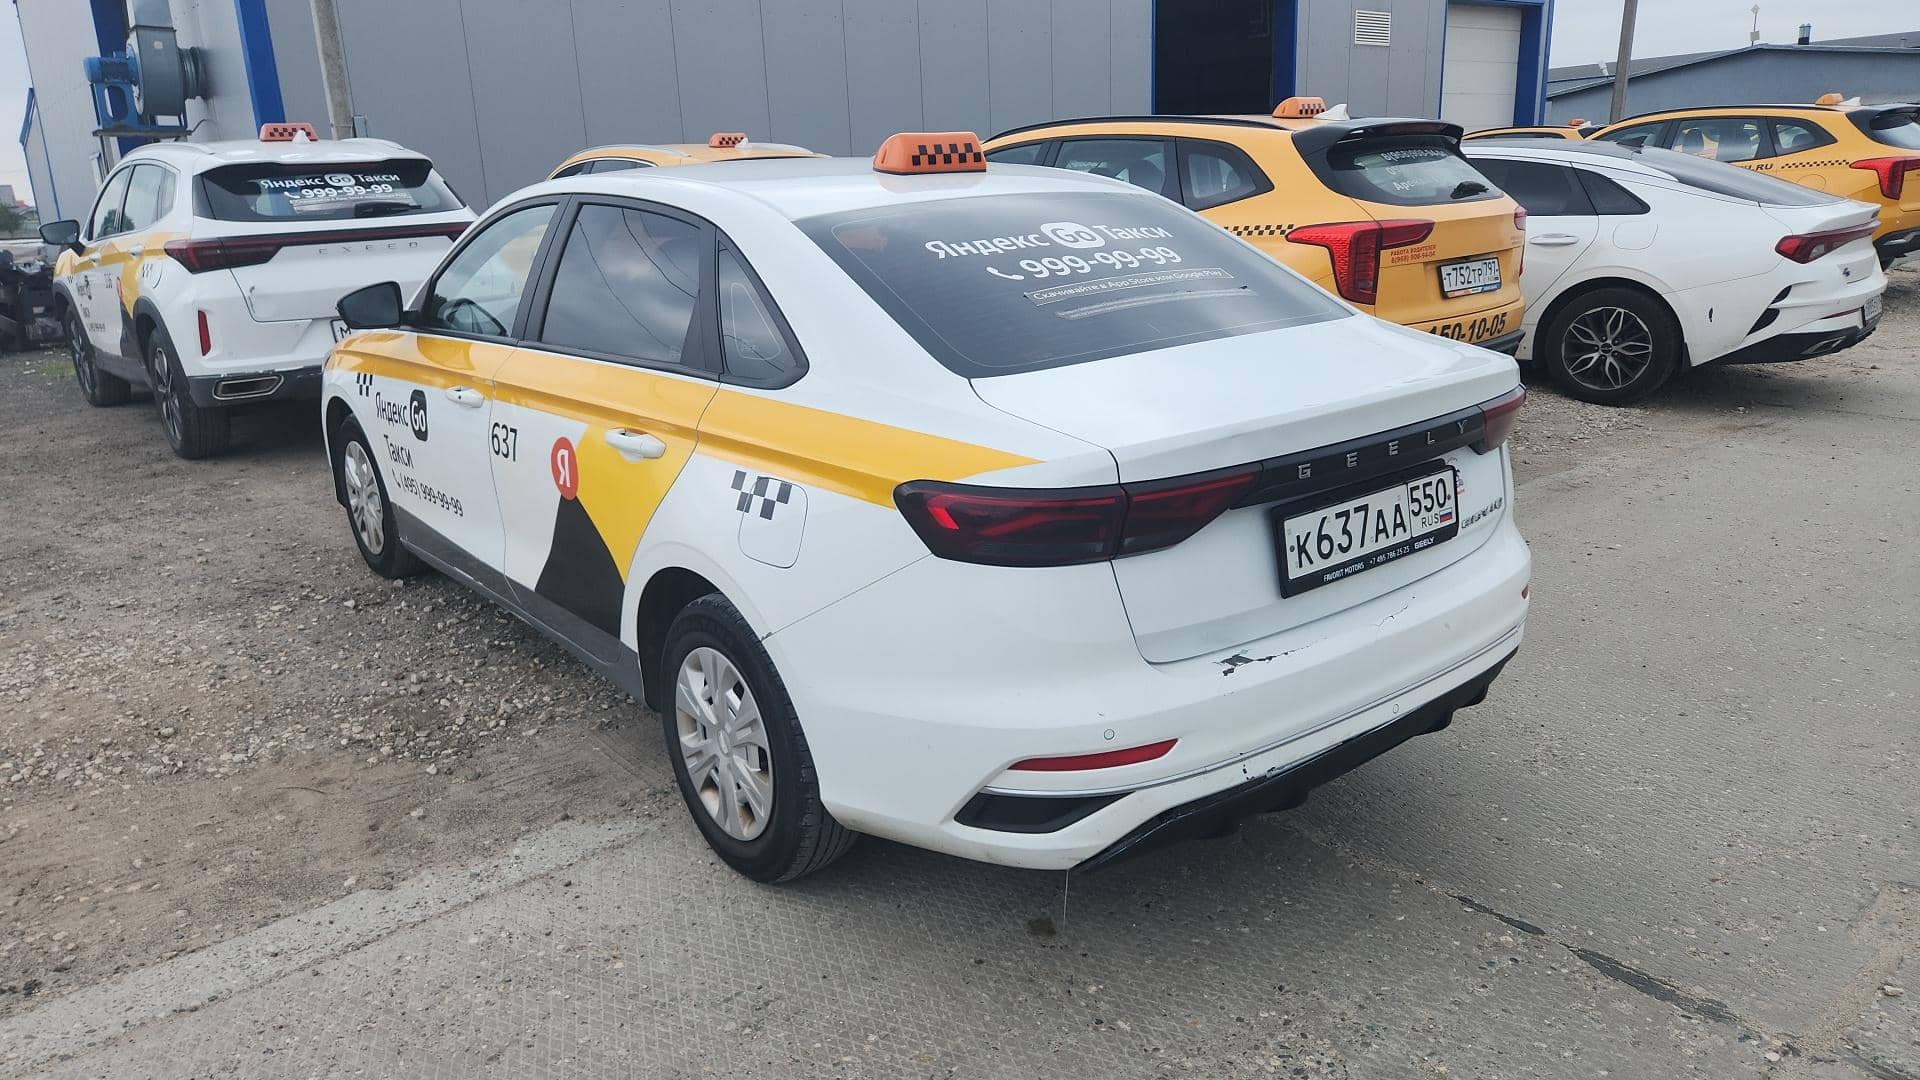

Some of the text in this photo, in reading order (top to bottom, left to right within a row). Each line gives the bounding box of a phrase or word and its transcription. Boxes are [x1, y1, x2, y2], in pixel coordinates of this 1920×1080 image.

[260, 174, 400, 189] Яндекс Go Такси
[301, 184, 393, 198] 999-99-99
[318, 241, 418, 254] EXEED
[925, 224, 1174, 259] Яндекс Go Такси
[1020, 246, 1182, 278] 999-99-99
[1033, 284, 1099, 300] Скачивайте
[1108, 280, 1129, 289] App
[1129, 277, 1154, 287] Store
[375, 391, 427, 434] Яндекс Go
[383, 434, 414, 469] Такси
[491, 422, 518, 462] 637
[1297, 420, 1468, 480] GEELY
[556, 448, 571, 488] Я
[399, 473, 464, 517] (495) 999-99-99
[1409, 477, 1446, 517] 550
[1421, 513, 1439, 528] RUS
[1323, 569, 1344, 582] FAVORIT
[1344, 561, 1365, 575] MOTORS
[1414, 536, 1435, 550] GEELY
